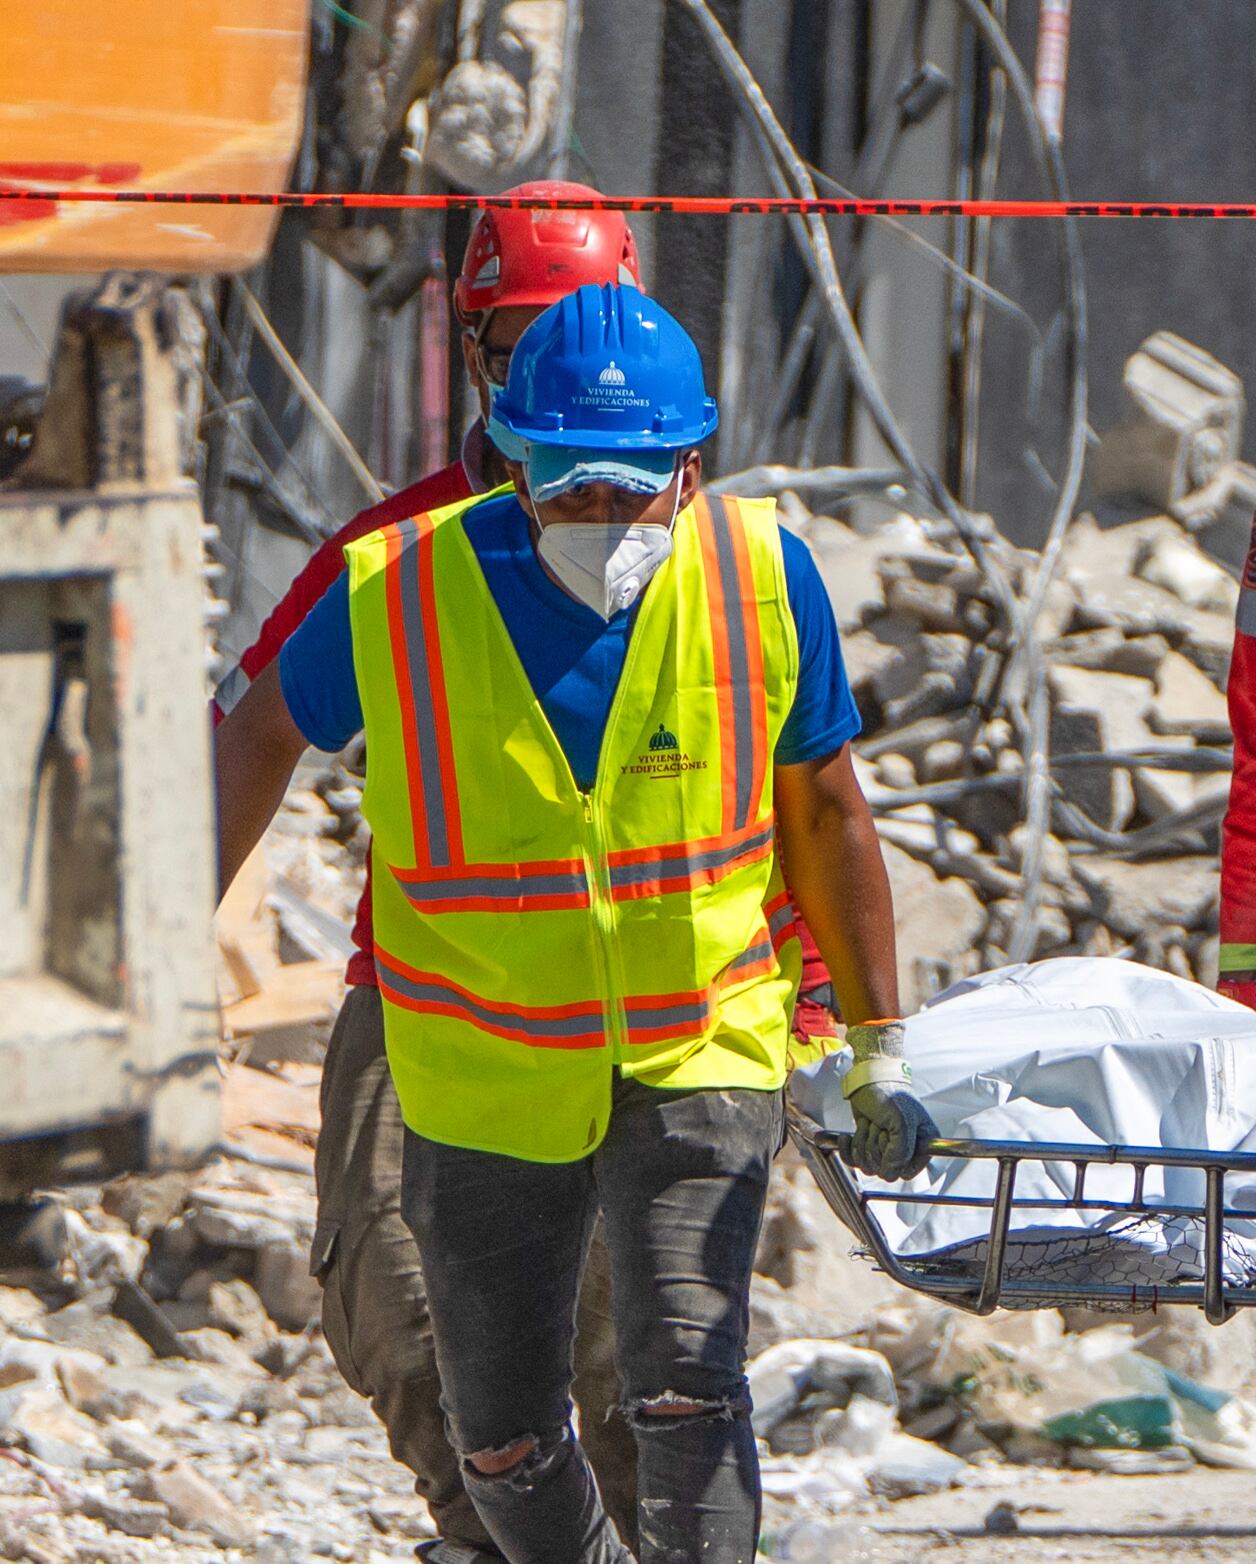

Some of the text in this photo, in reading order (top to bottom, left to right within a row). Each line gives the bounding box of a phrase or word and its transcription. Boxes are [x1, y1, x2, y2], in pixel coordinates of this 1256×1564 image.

[587, 387, 635, 397] VIVIENDA
[580, 396, 650, 408] EDIFICACIONES
[638, 753, 689, 764] VIVIENDA
[621, 761, 708, 774] Y EDIFICACIONES
